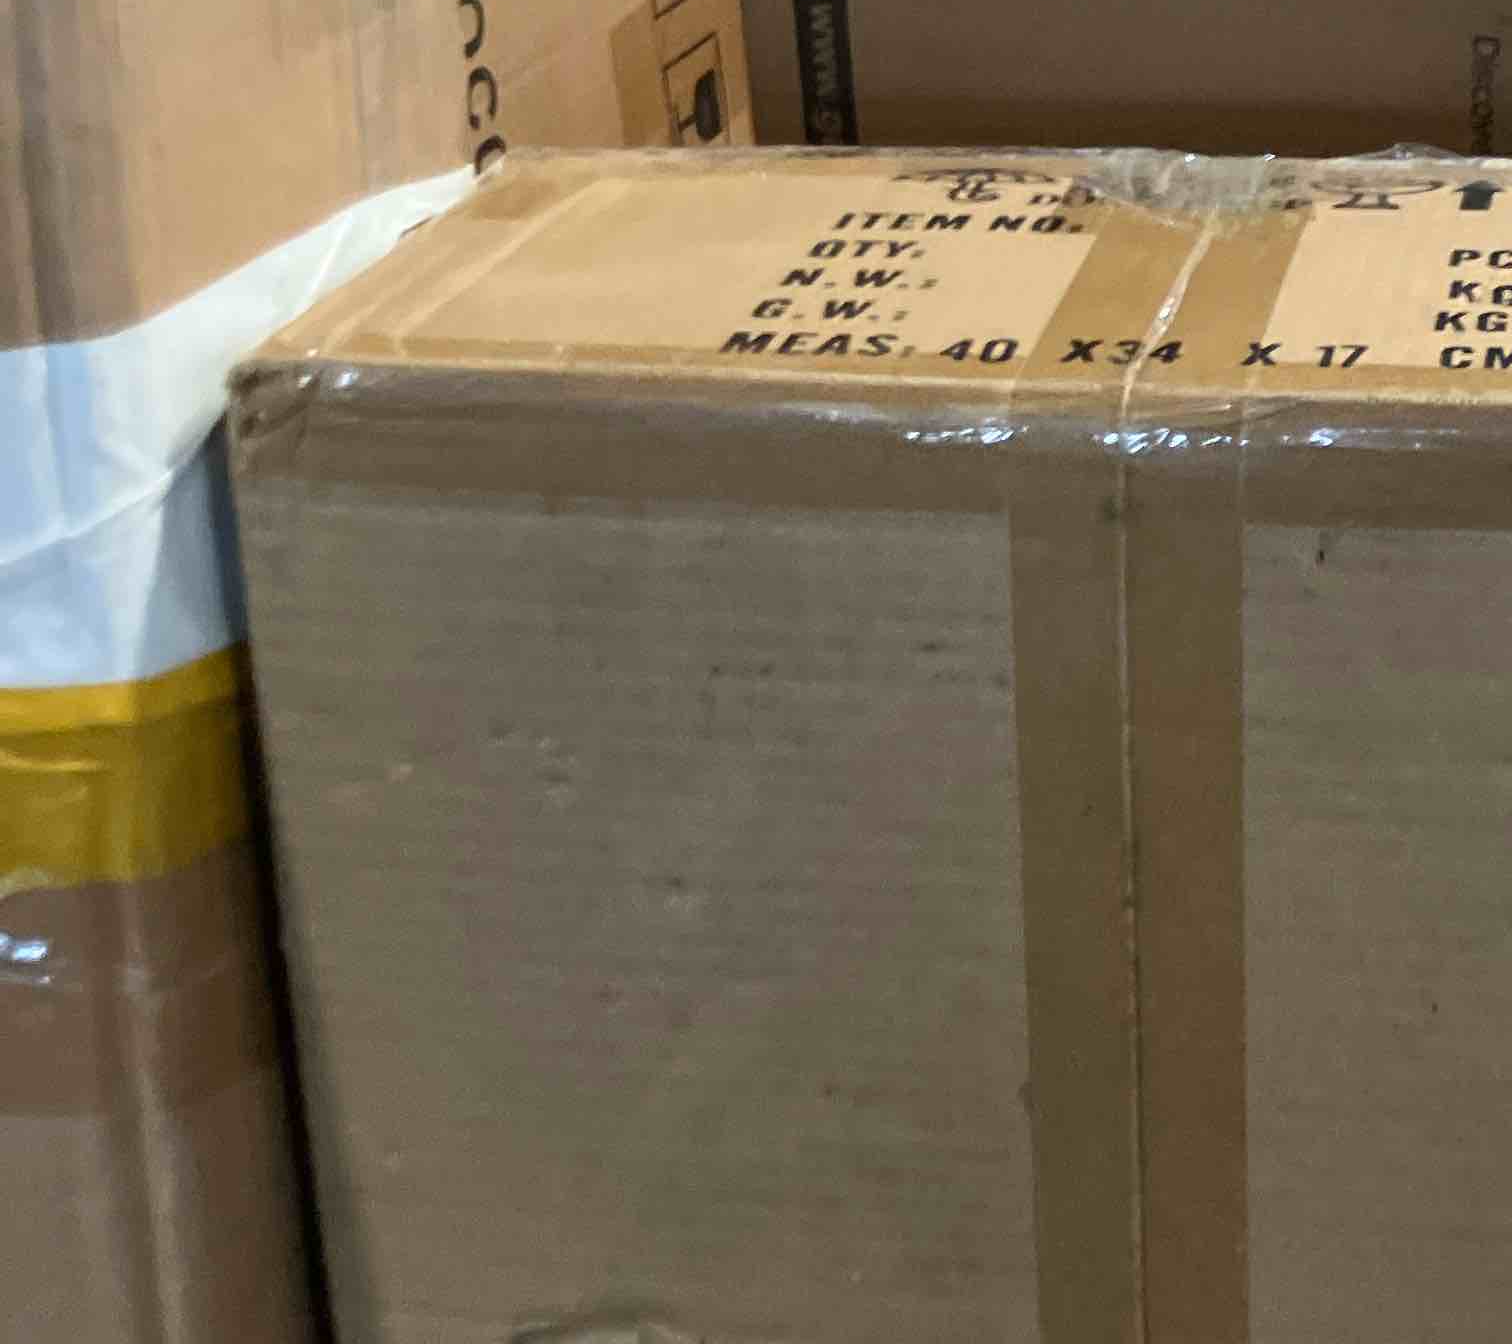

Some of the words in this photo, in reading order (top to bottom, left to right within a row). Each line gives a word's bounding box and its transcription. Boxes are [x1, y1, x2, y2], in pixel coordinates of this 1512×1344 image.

[833, 211, 972, 231] ITEM
[989, 214, 1084, 233] NO.
[939, 338, 1019, 363] 40
[1241, 342, 1281, 367] X
[1315, 346, 1370, 368] 17
